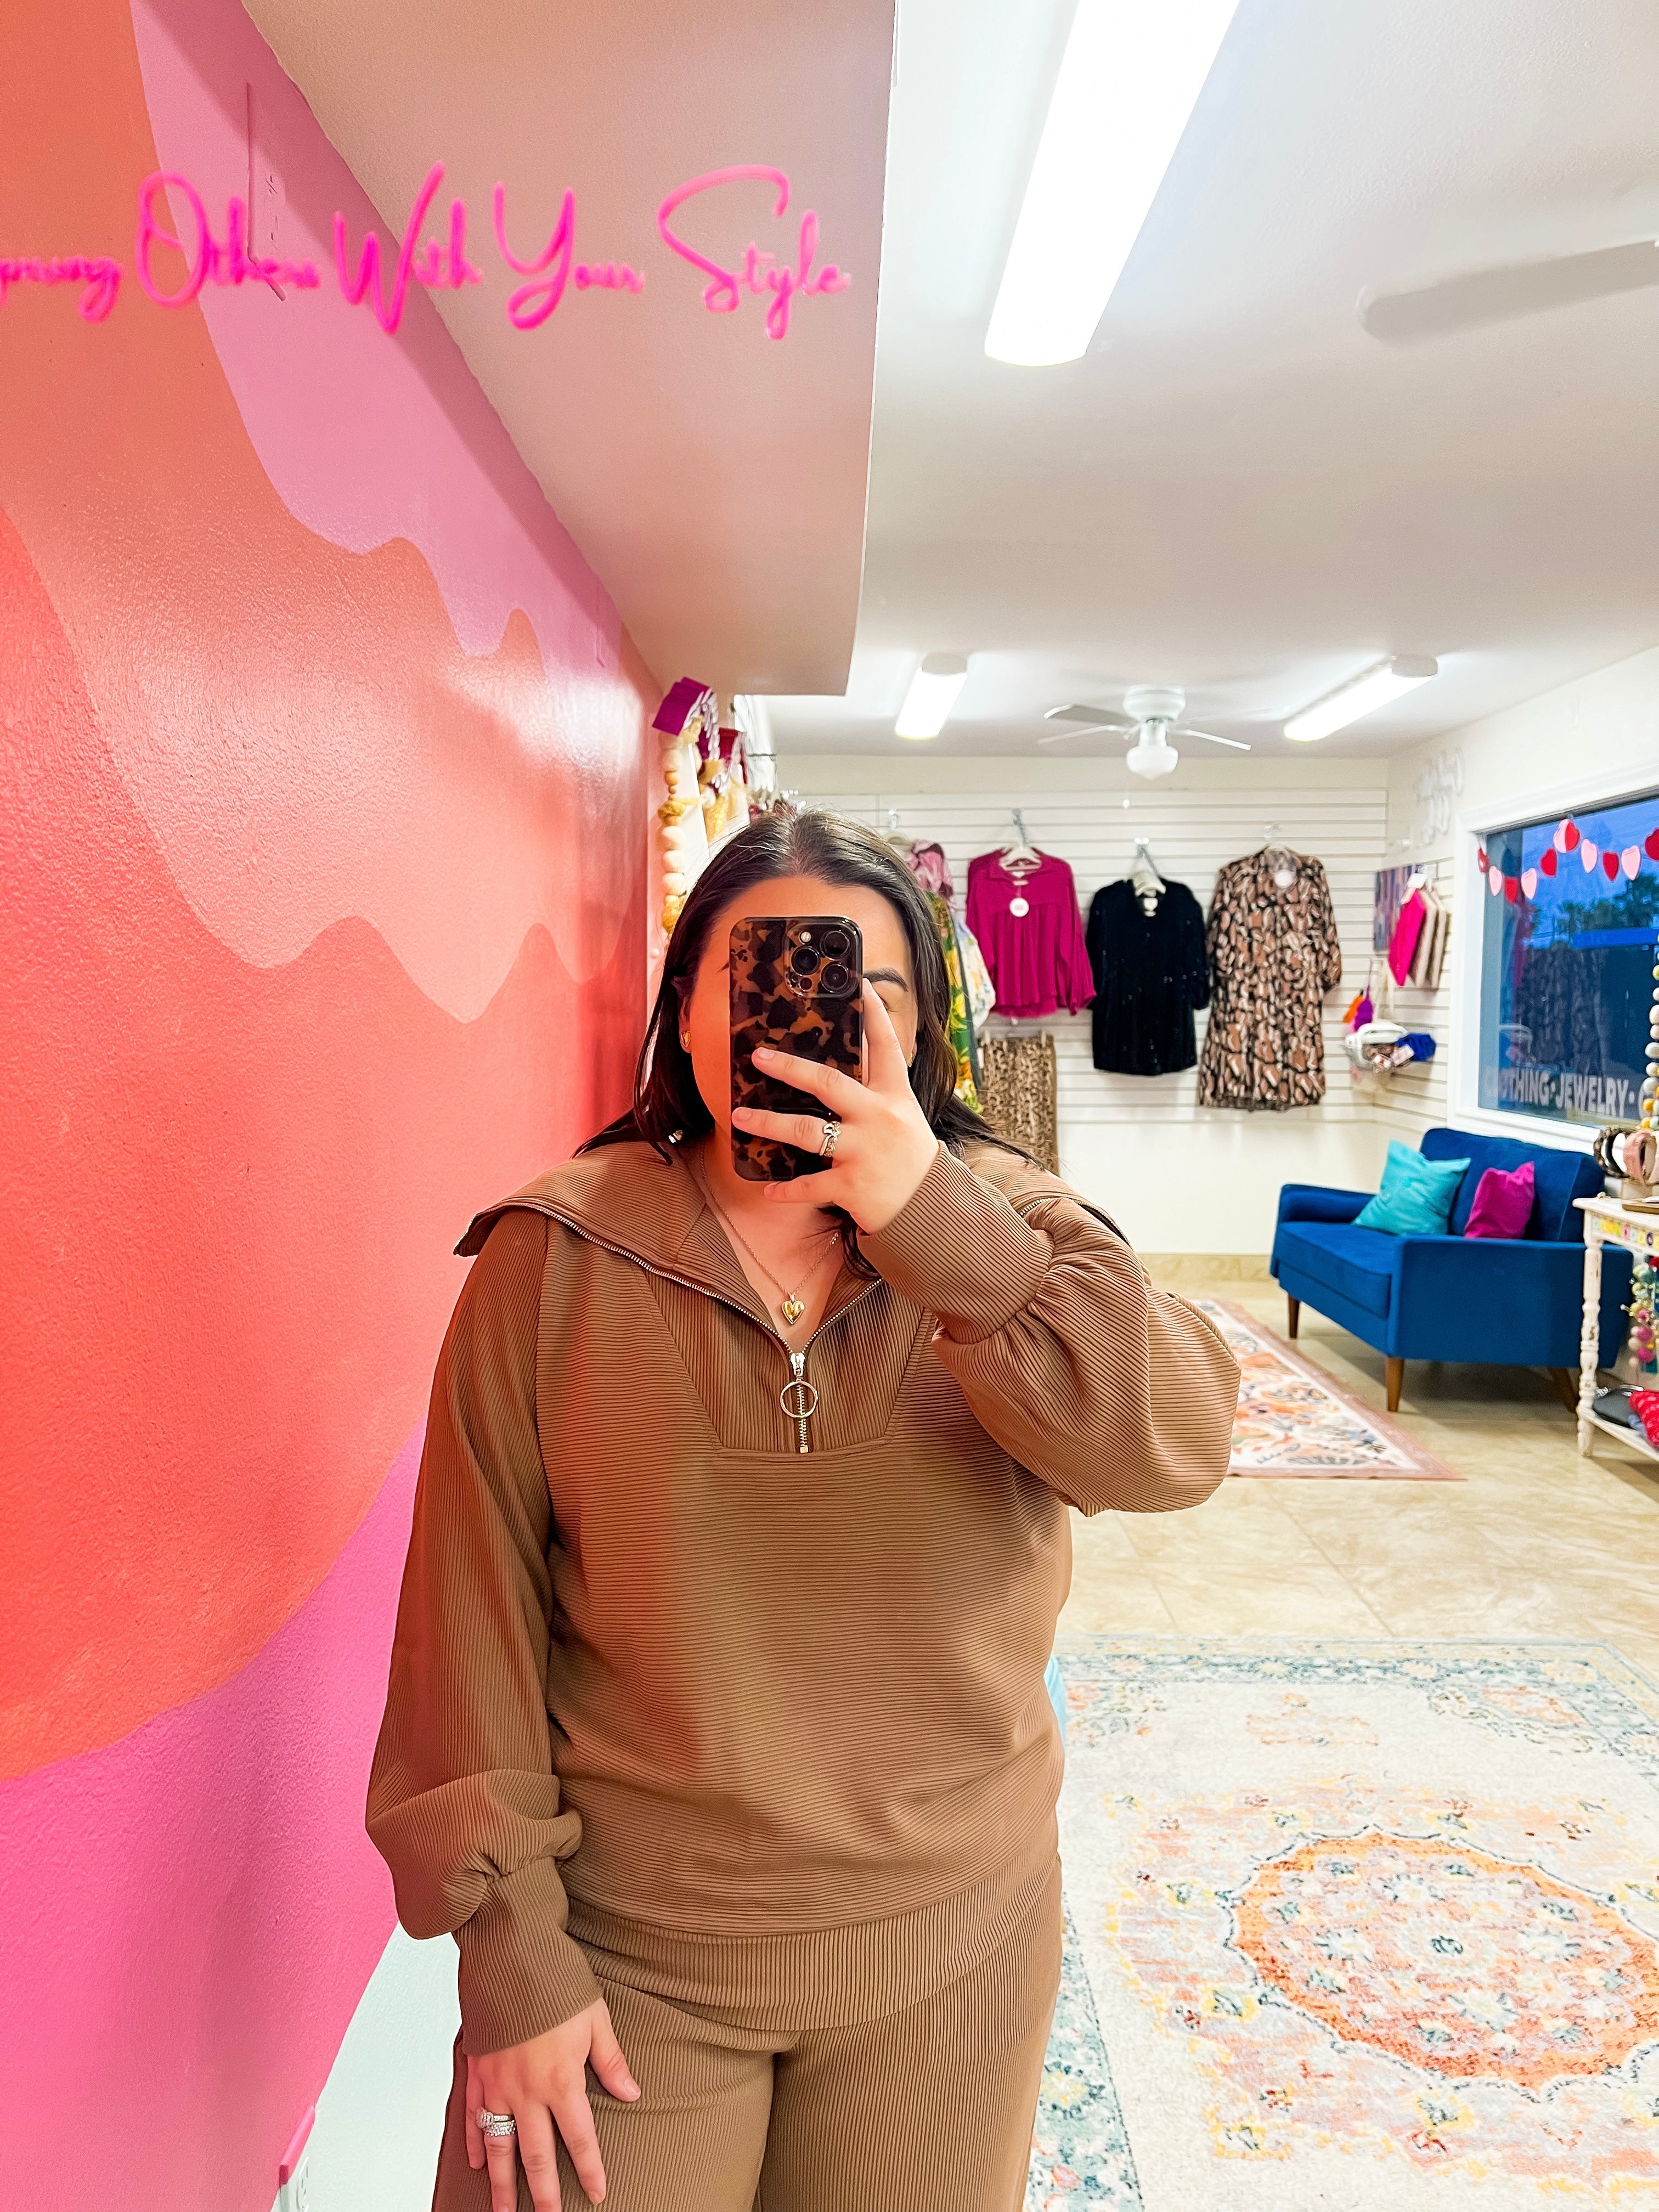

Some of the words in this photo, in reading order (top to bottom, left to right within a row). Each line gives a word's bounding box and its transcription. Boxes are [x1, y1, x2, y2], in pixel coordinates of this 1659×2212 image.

[136, 172, 320, 308] Others
[332, 160, 482, 335] With
[492, 182, 646, 330] Your
[658, 164, 851, 341] Style
[1556, 1072, 1629, 1118] JEWELRY
